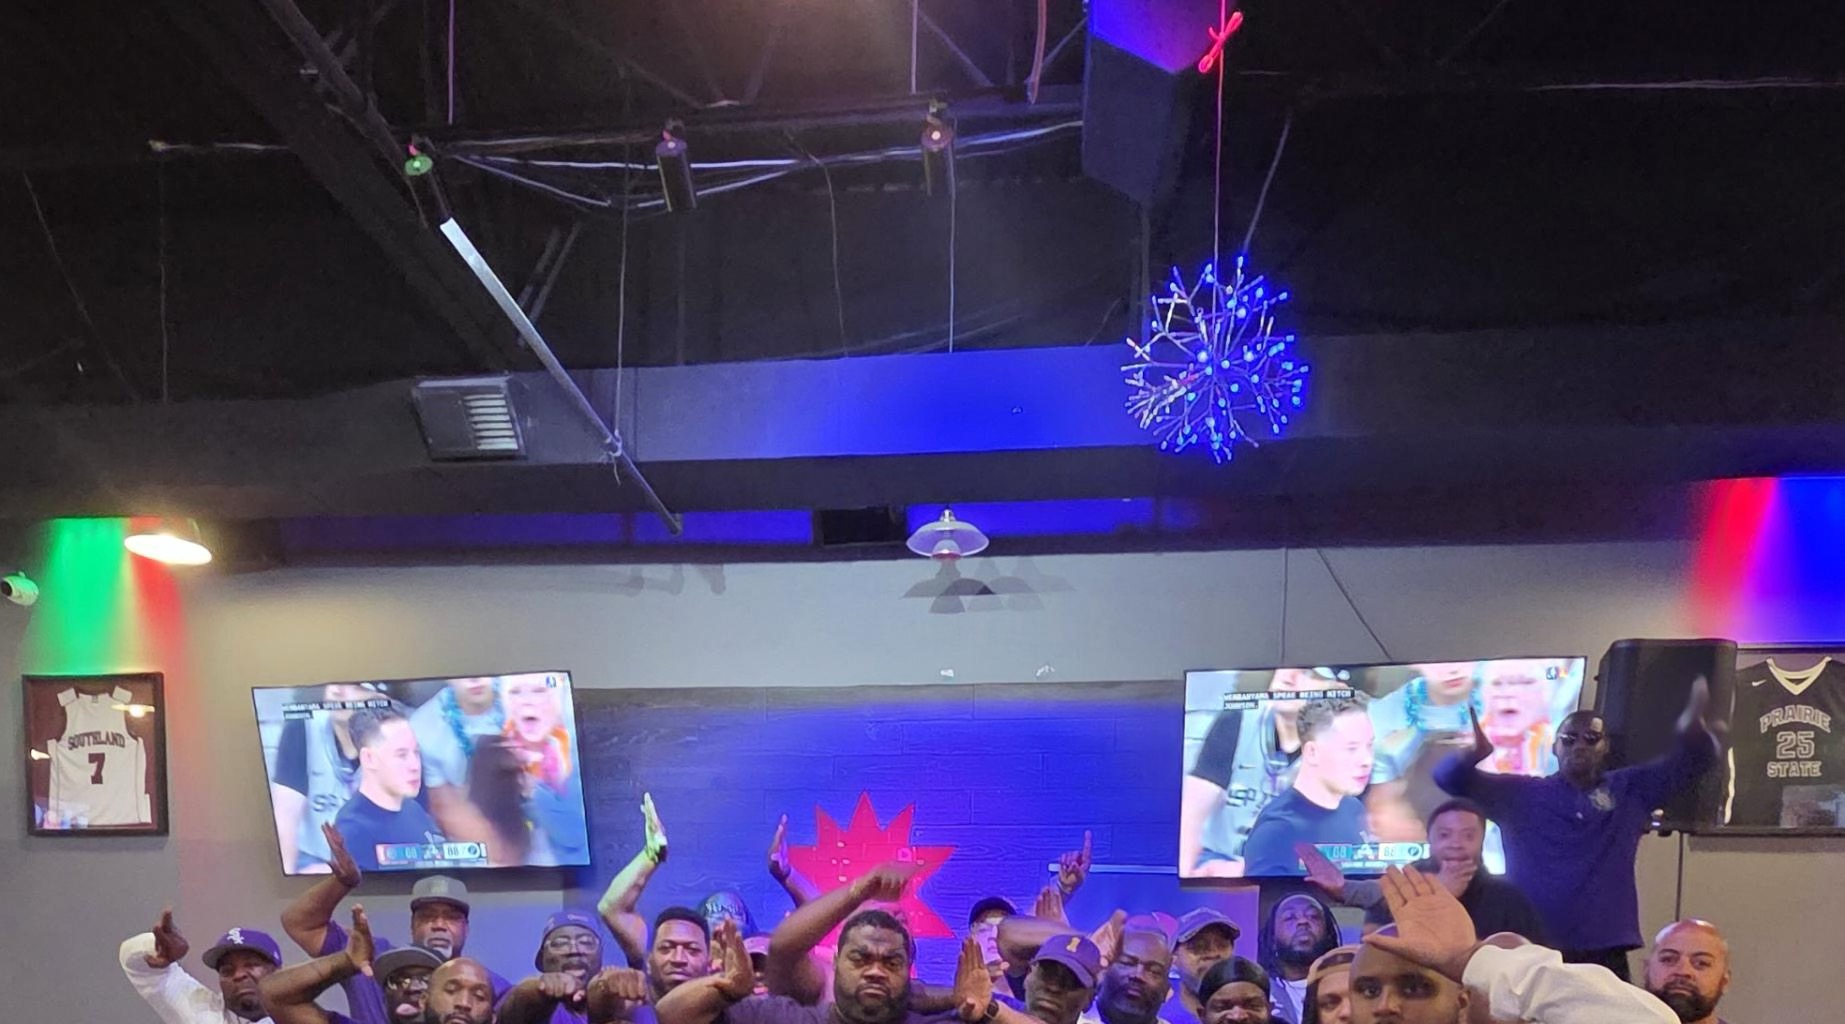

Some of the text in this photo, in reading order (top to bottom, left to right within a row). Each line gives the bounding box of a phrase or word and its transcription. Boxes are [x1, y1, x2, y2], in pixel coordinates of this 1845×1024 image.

[1760, 704, 1831, 734] PRAIRIE
[68, 731, 125, 751] SOUTHLAND
[1776, 731, 1815, 759] 25
[88, 752, 105, 785] 7
[1767, 761, 1822, 778] STATE
